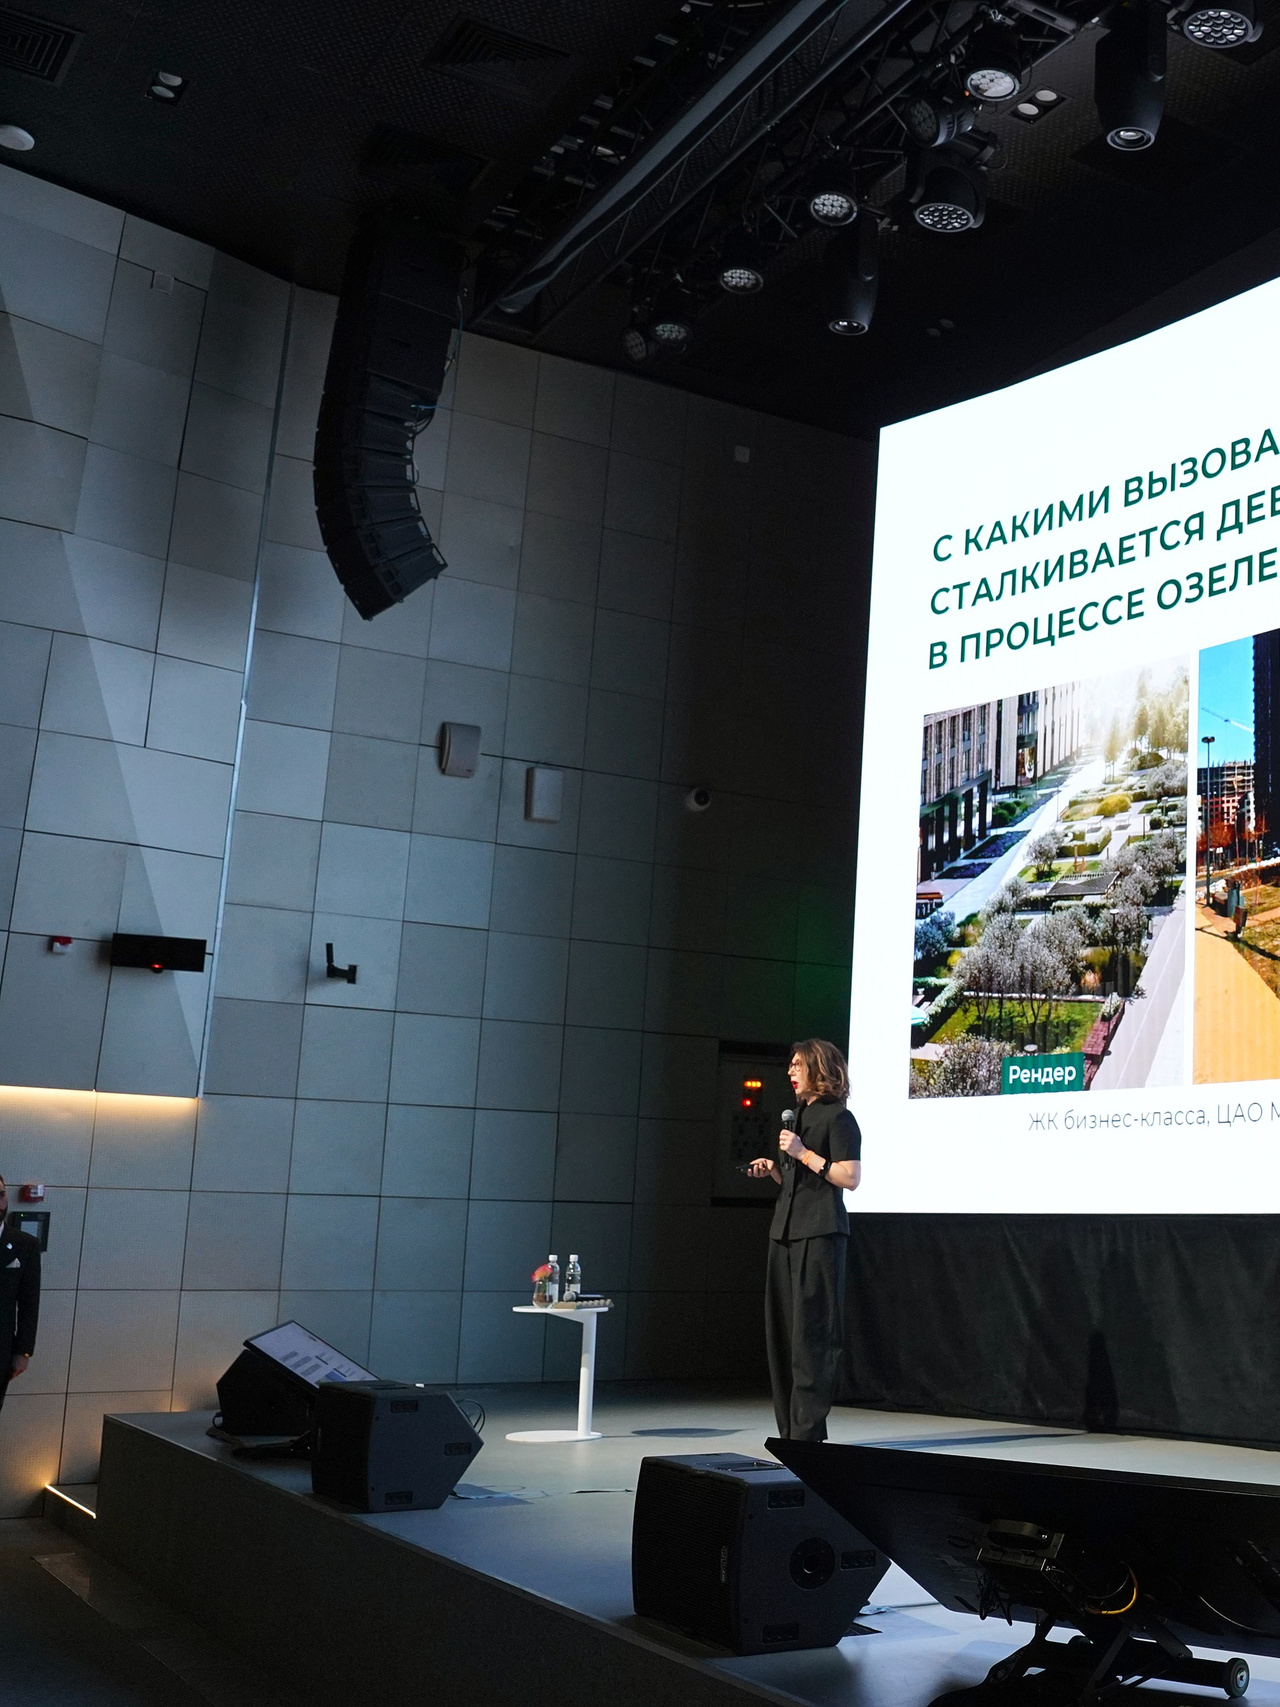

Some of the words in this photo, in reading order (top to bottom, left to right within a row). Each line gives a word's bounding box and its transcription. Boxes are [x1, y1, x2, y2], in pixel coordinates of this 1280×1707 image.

[933, 534, 953, 562] С
[964, 485, 1110, 555] КАКИМИ
[931, 511, 1204, 615] СТАЛКИВАЕТСЯ
[929, 641, 948, 670] В
[960, 587, 1145, 663] ПРОЦЕССЕ
[1010, 1066, 1076, 1084] Рендер
[1029, 1113, 1057, 1130] ЖК
[1065, 1109, 1209, 1129] бизнес-класса,
[1218, 1102, 1262, 1127] ЦАО
